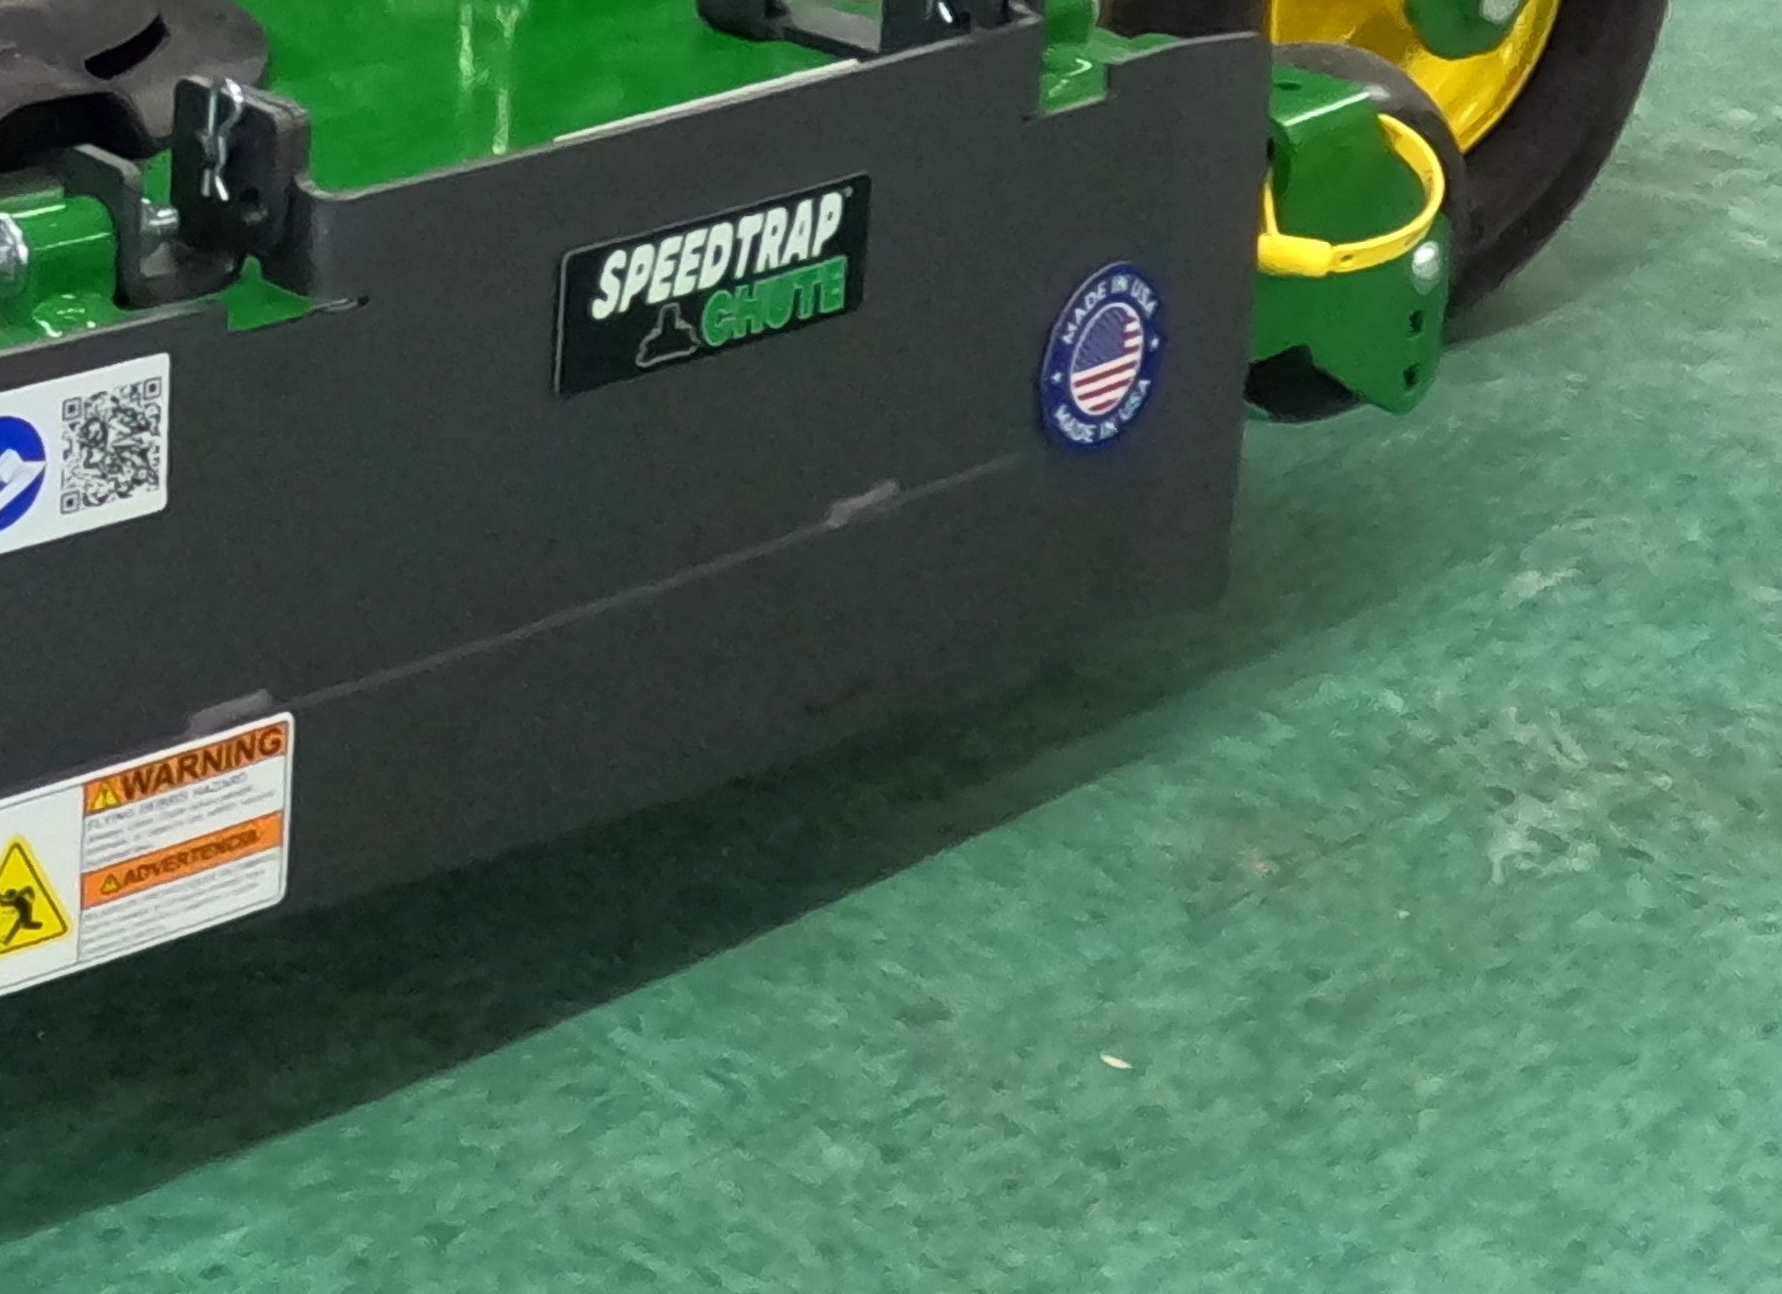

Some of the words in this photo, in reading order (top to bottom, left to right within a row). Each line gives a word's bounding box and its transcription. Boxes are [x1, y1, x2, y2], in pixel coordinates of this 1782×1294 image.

[591, 190, 844, 321] SPEEDTRAP
[700, 254, 849, 348] CHUTE
[1062, 280, 1107, 345] MADE
[1111, 274, 1130, 294] IN
[1130, 276, 1159, 318] USA
[1053, 403, 1097, 444] MADE
[1100, 420, 1119, 440] IN
[1119, 379, 1152, 422] USA
[121, 727, 283, 801] WARNING
[122, 828, 261, 886] ADVERTENCIA
